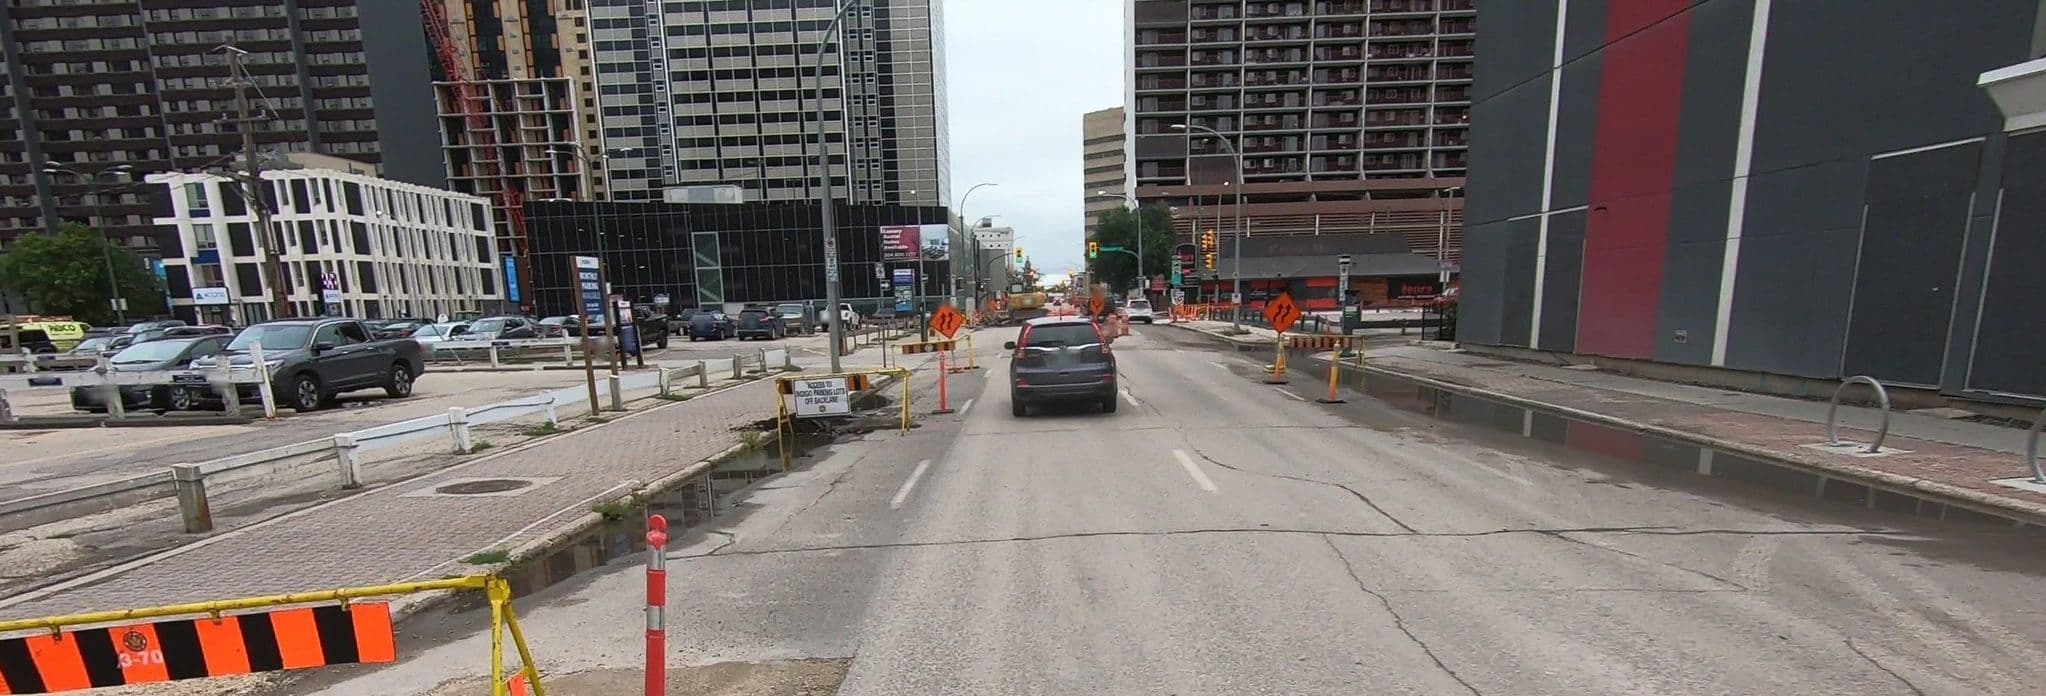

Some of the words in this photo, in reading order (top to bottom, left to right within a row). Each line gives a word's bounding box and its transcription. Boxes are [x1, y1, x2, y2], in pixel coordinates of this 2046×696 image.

[807, 381, 826, 389] ACCESS
[825, 380, 833, 388] TO
[813, 388, 832, 397] PARKING
[832, 387, 845, 395] LOTS
[804, 397, 813, 405] OFF
